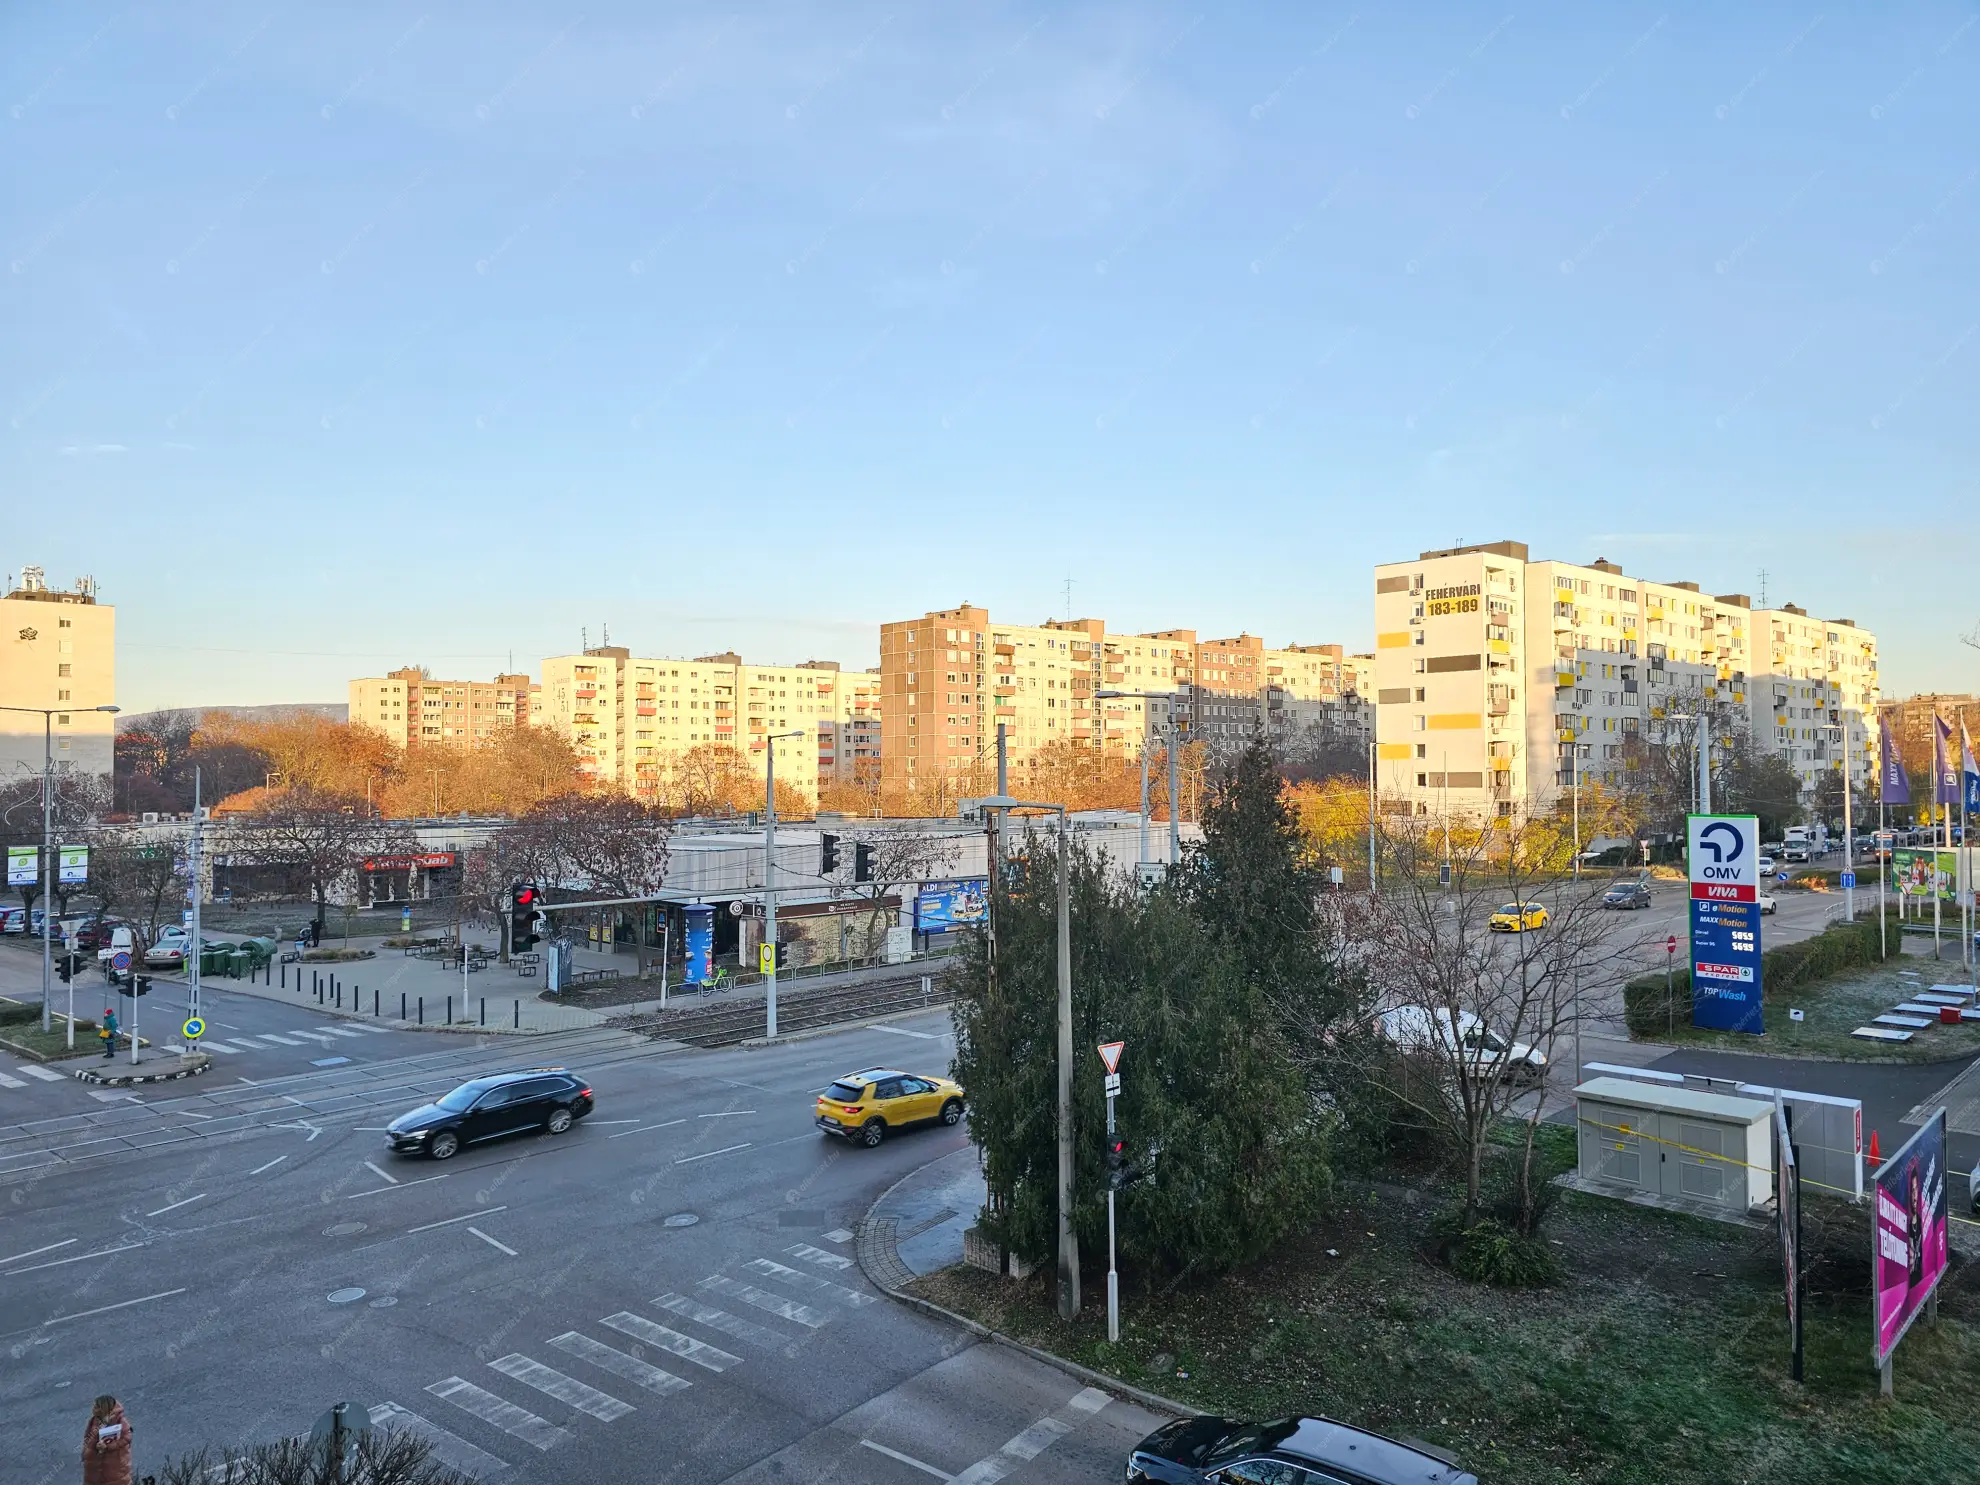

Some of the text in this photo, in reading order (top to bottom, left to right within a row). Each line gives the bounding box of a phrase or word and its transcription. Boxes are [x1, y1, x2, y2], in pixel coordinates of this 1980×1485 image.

[1428, 599, 1478, 616] 183-189
[1704, 866, 1741, 880] OMV
[922, 884, 938, 892] ALDI
[1708, 886, 1738, 898] VIVA
[1704, 965, 1739, 974] SPAR
[1704, 972, 1740, 980] express
